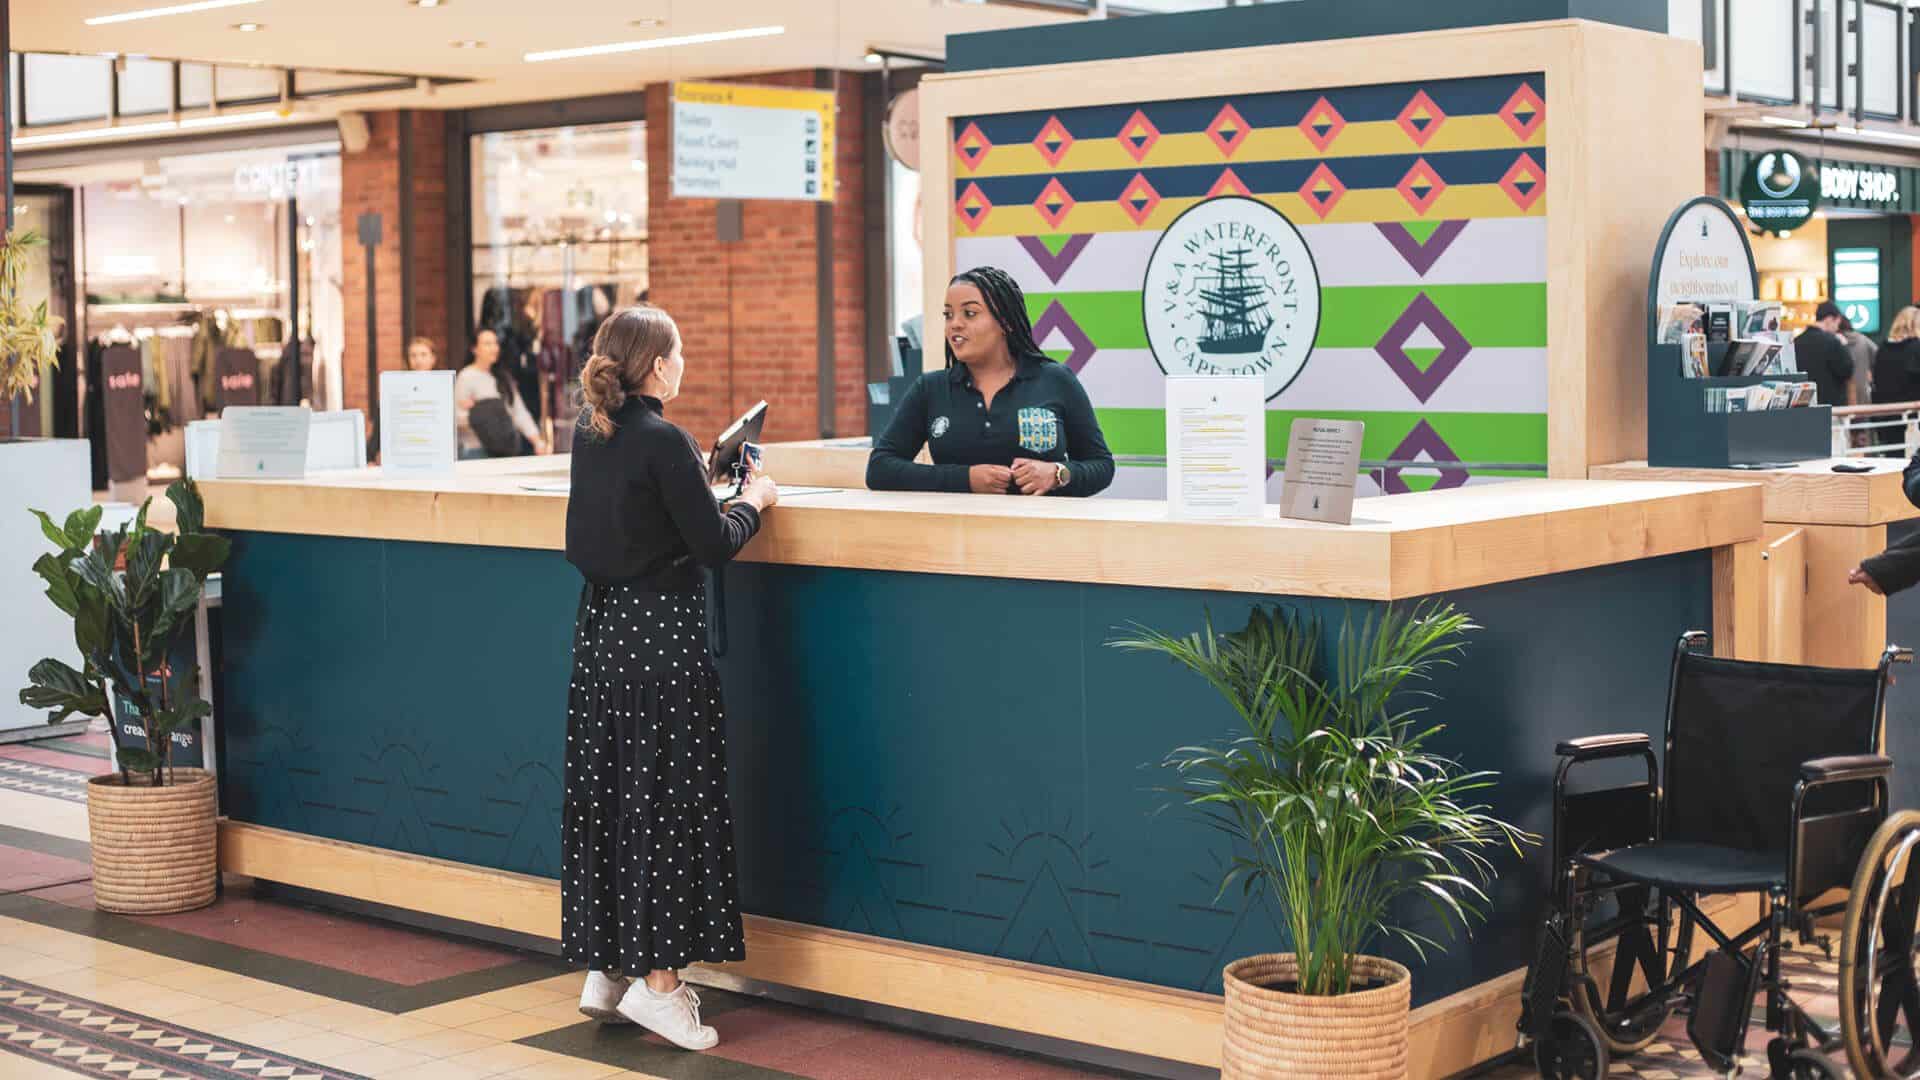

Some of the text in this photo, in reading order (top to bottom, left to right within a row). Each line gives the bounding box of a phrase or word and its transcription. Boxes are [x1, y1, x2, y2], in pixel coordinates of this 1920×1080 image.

[1820, 165, 1859, 200] BODY
[1163, 221, 1298, 313] V&A WATERFRONT
[1679, 249, 1713, 271] Explore
